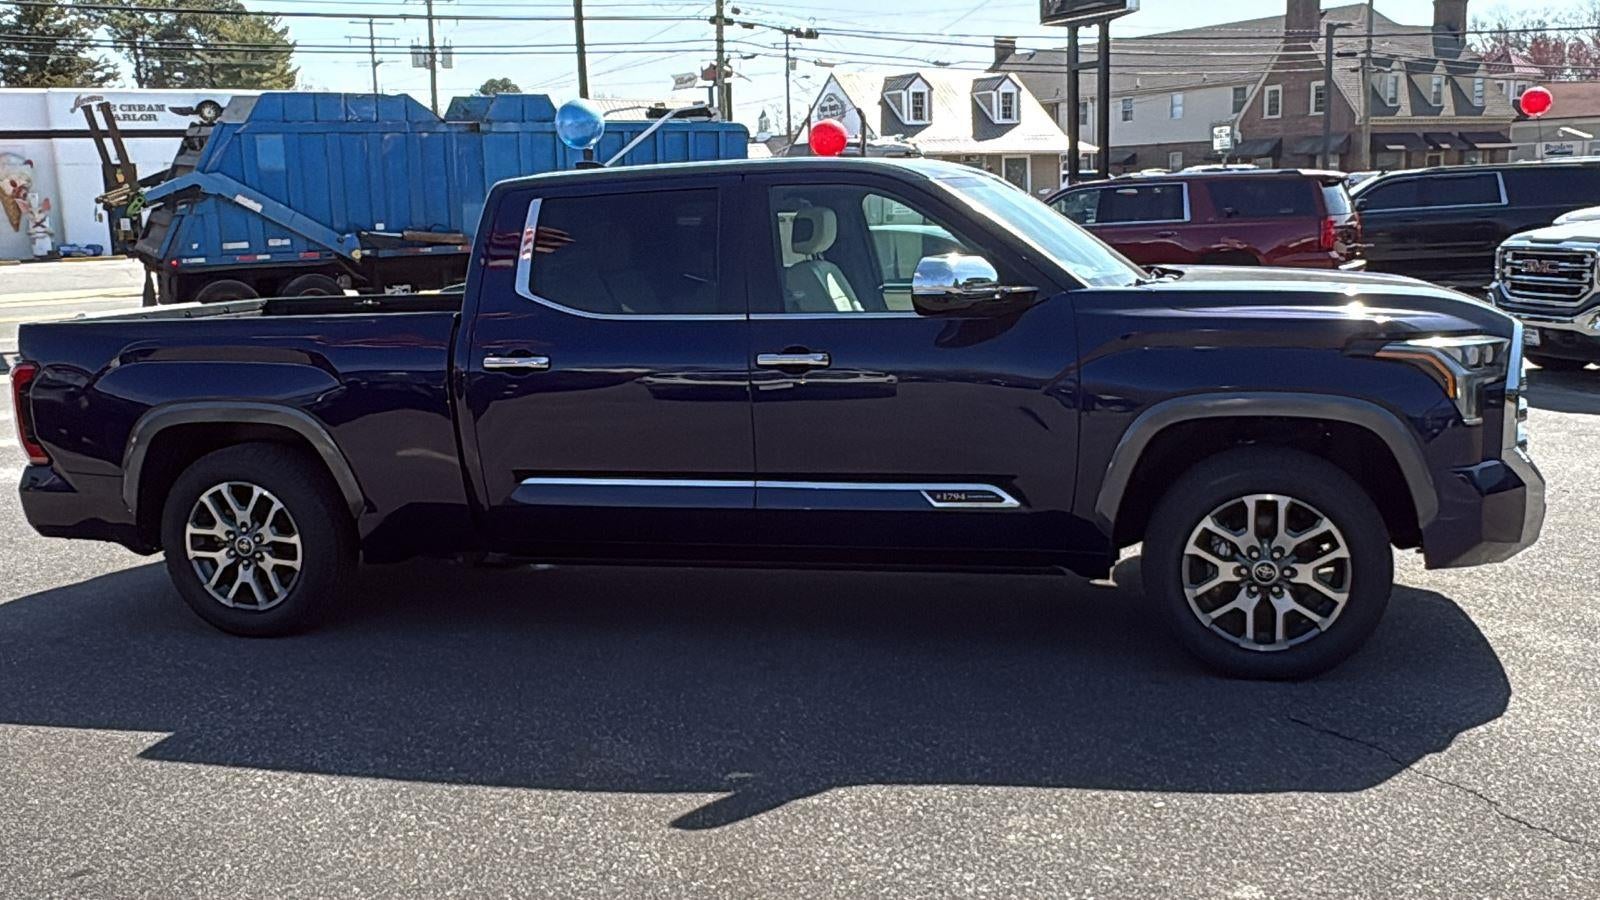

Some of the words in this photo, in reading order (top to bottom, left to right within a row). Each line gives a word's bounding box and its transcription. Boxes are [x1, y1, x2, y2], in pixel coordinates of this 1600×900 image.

[96, 103, 117, 112] IE
[119, 103, 166, 112] CREAM
[112, 113, 158, 122] ARLOR
[1521, 259, 1559, 273] GMC
